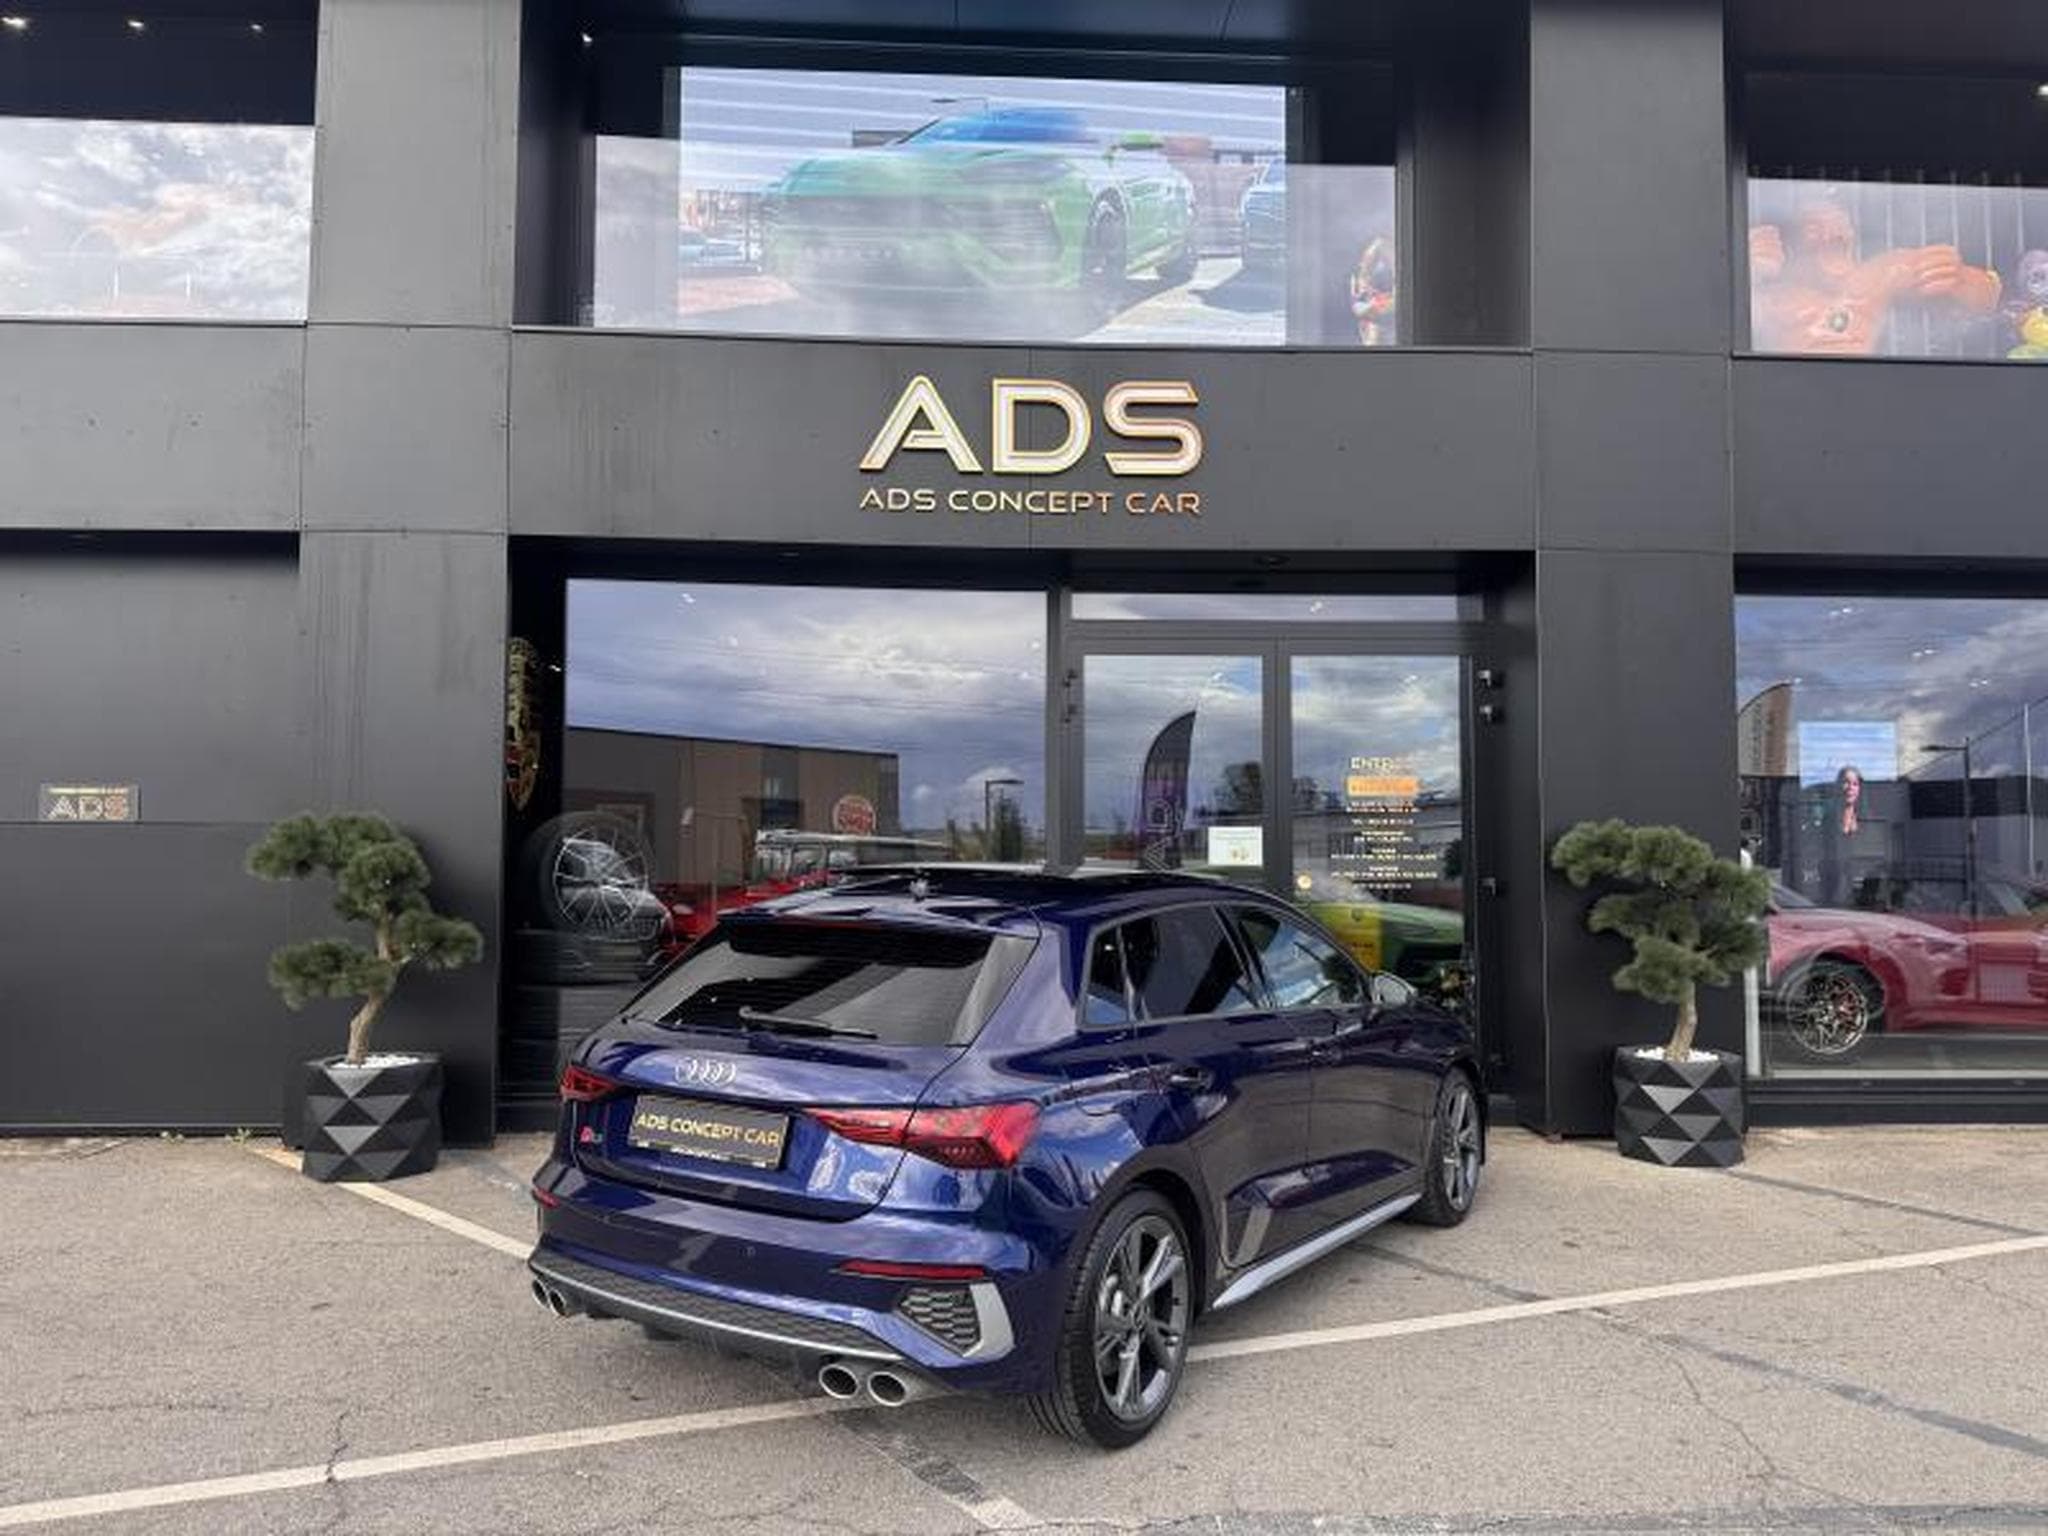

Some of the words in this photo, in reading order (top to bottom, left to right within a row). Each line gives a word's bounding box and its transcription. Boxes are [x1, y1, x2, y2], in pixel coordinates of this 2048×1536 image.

[859, 375, 1202, 475] ADS
[859, 488, 936, 511] ADS
[948, 490, 1114, 513] CONCEPT
[1125, 492, 1200, 514] CAR
[47, 795, 129, 821] ADS
[637, 1112, 668, 1130] ADS
[670, 1117, 742, 1141] CONCEPT
[744, 1128, 780, 1147] CAR
